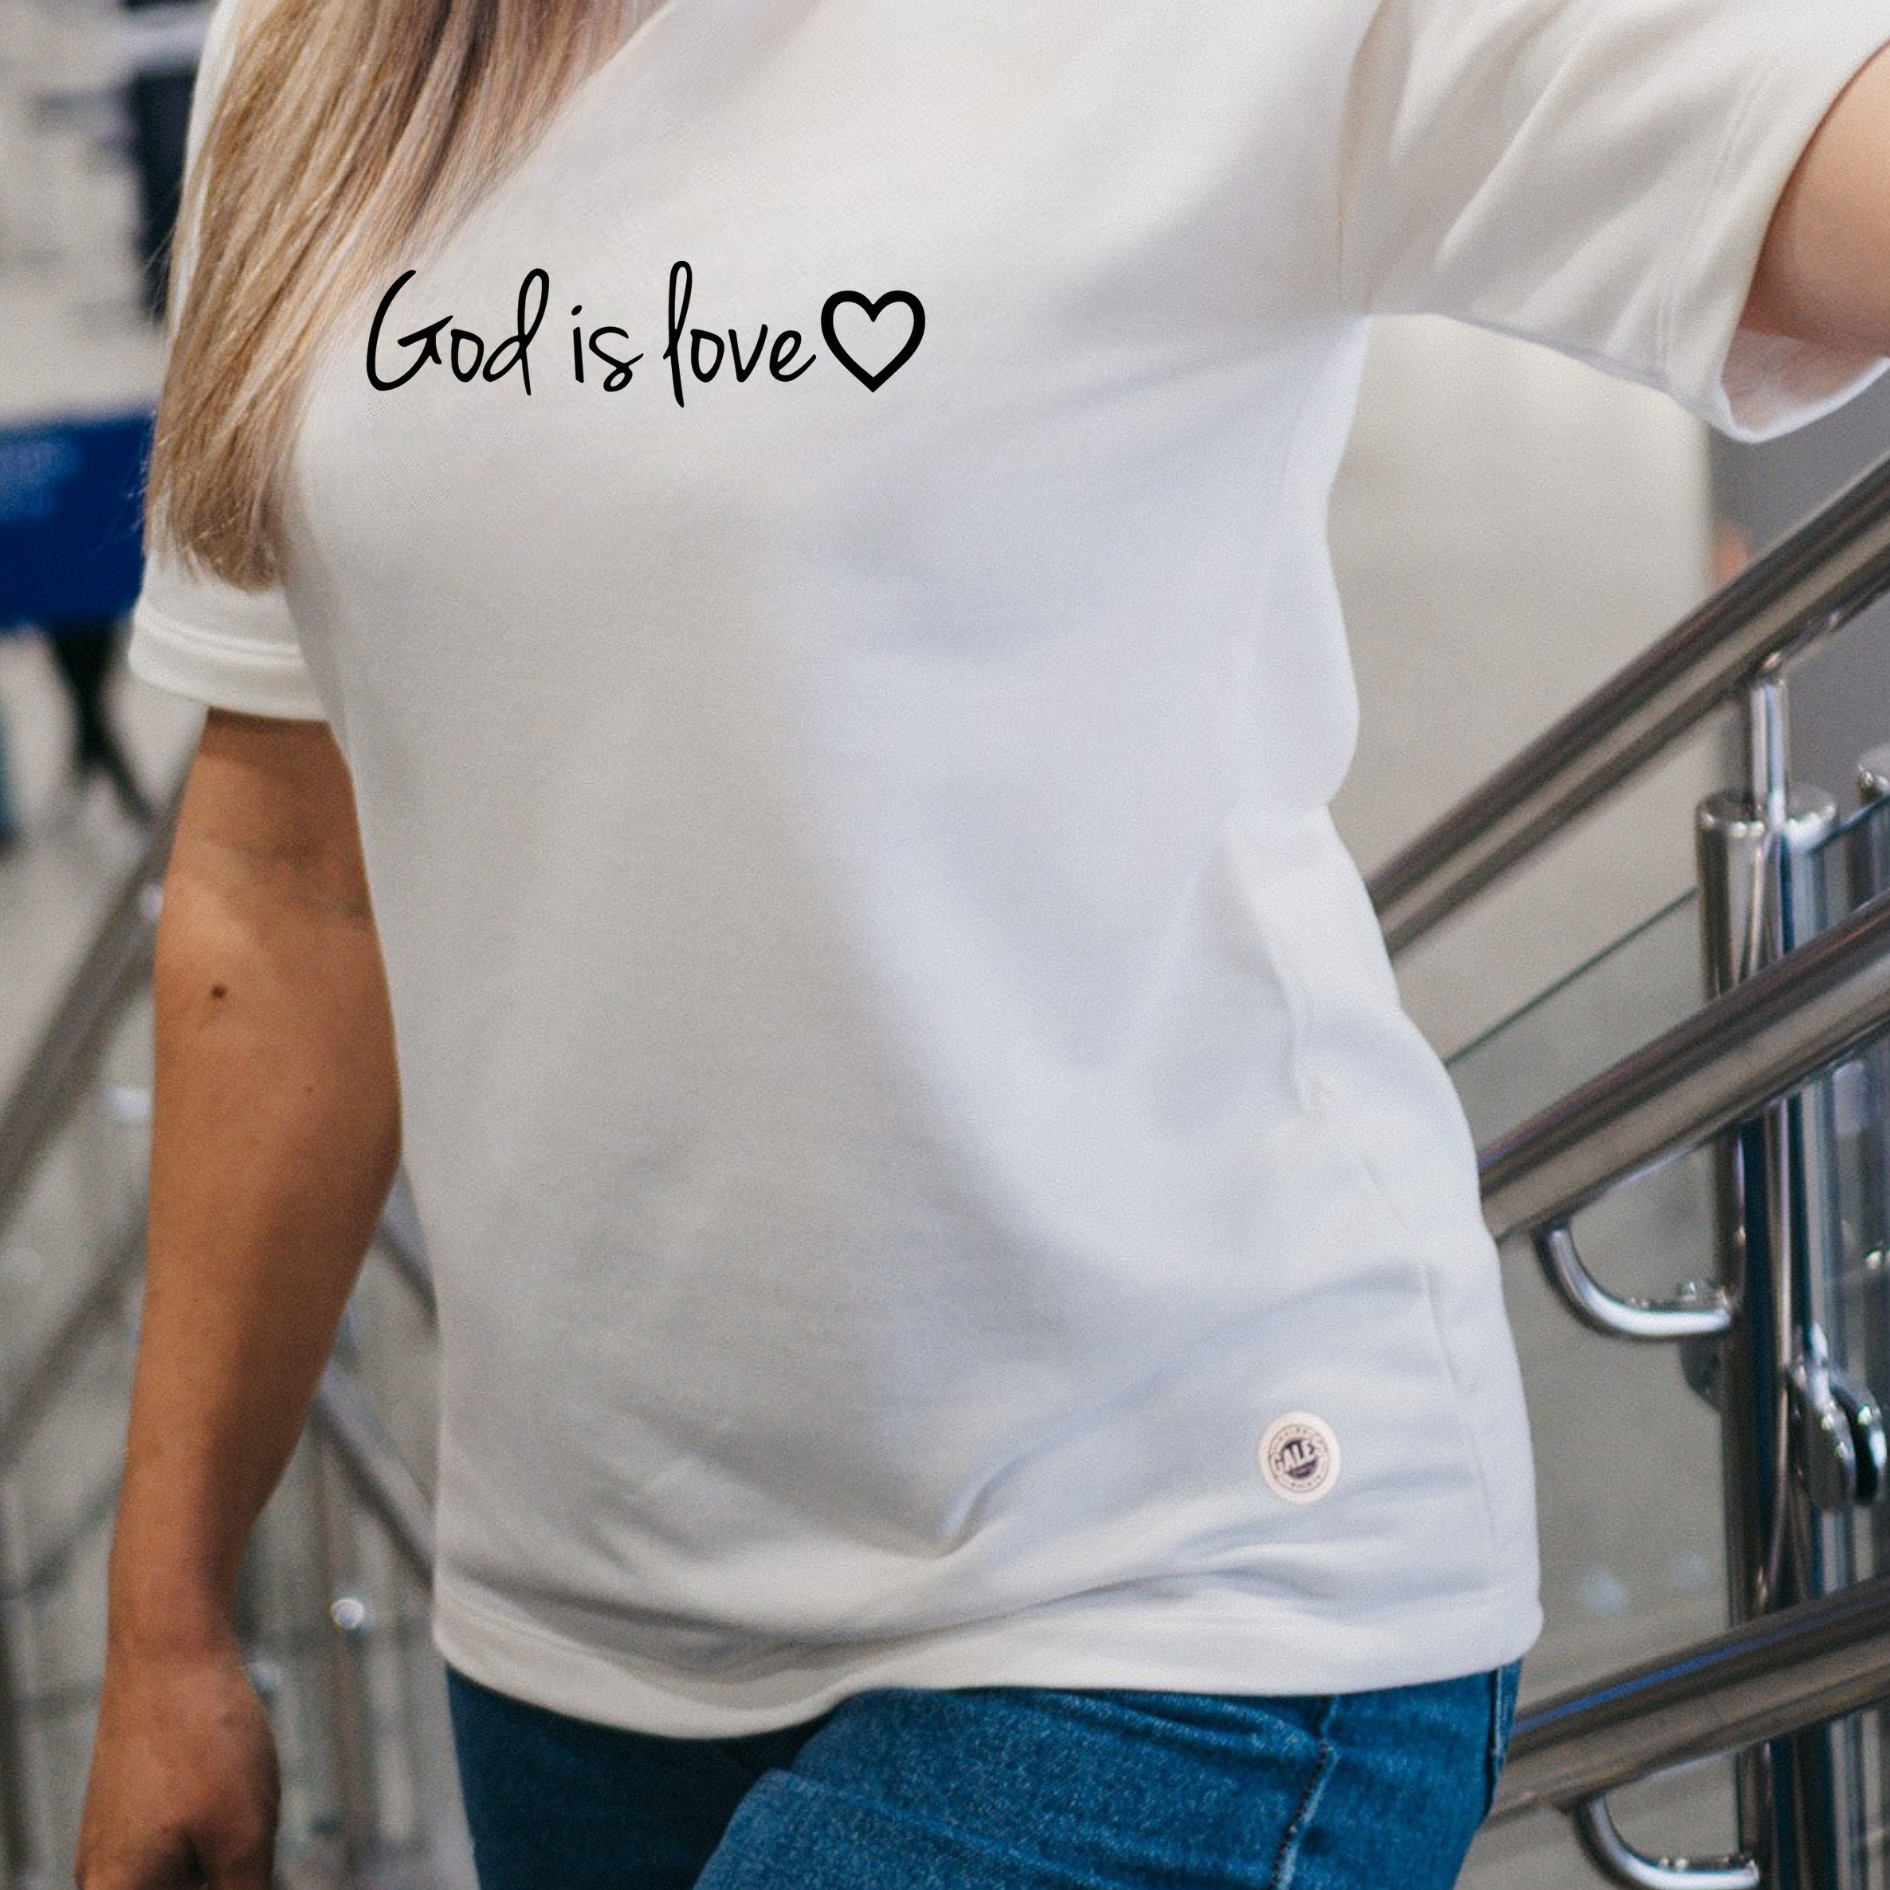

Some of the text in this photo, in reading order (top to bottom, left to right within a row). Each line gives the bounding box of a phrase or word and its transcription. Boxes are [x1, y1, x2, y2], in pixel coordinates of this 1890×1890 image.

[366, 260, 817, 408] God is love
